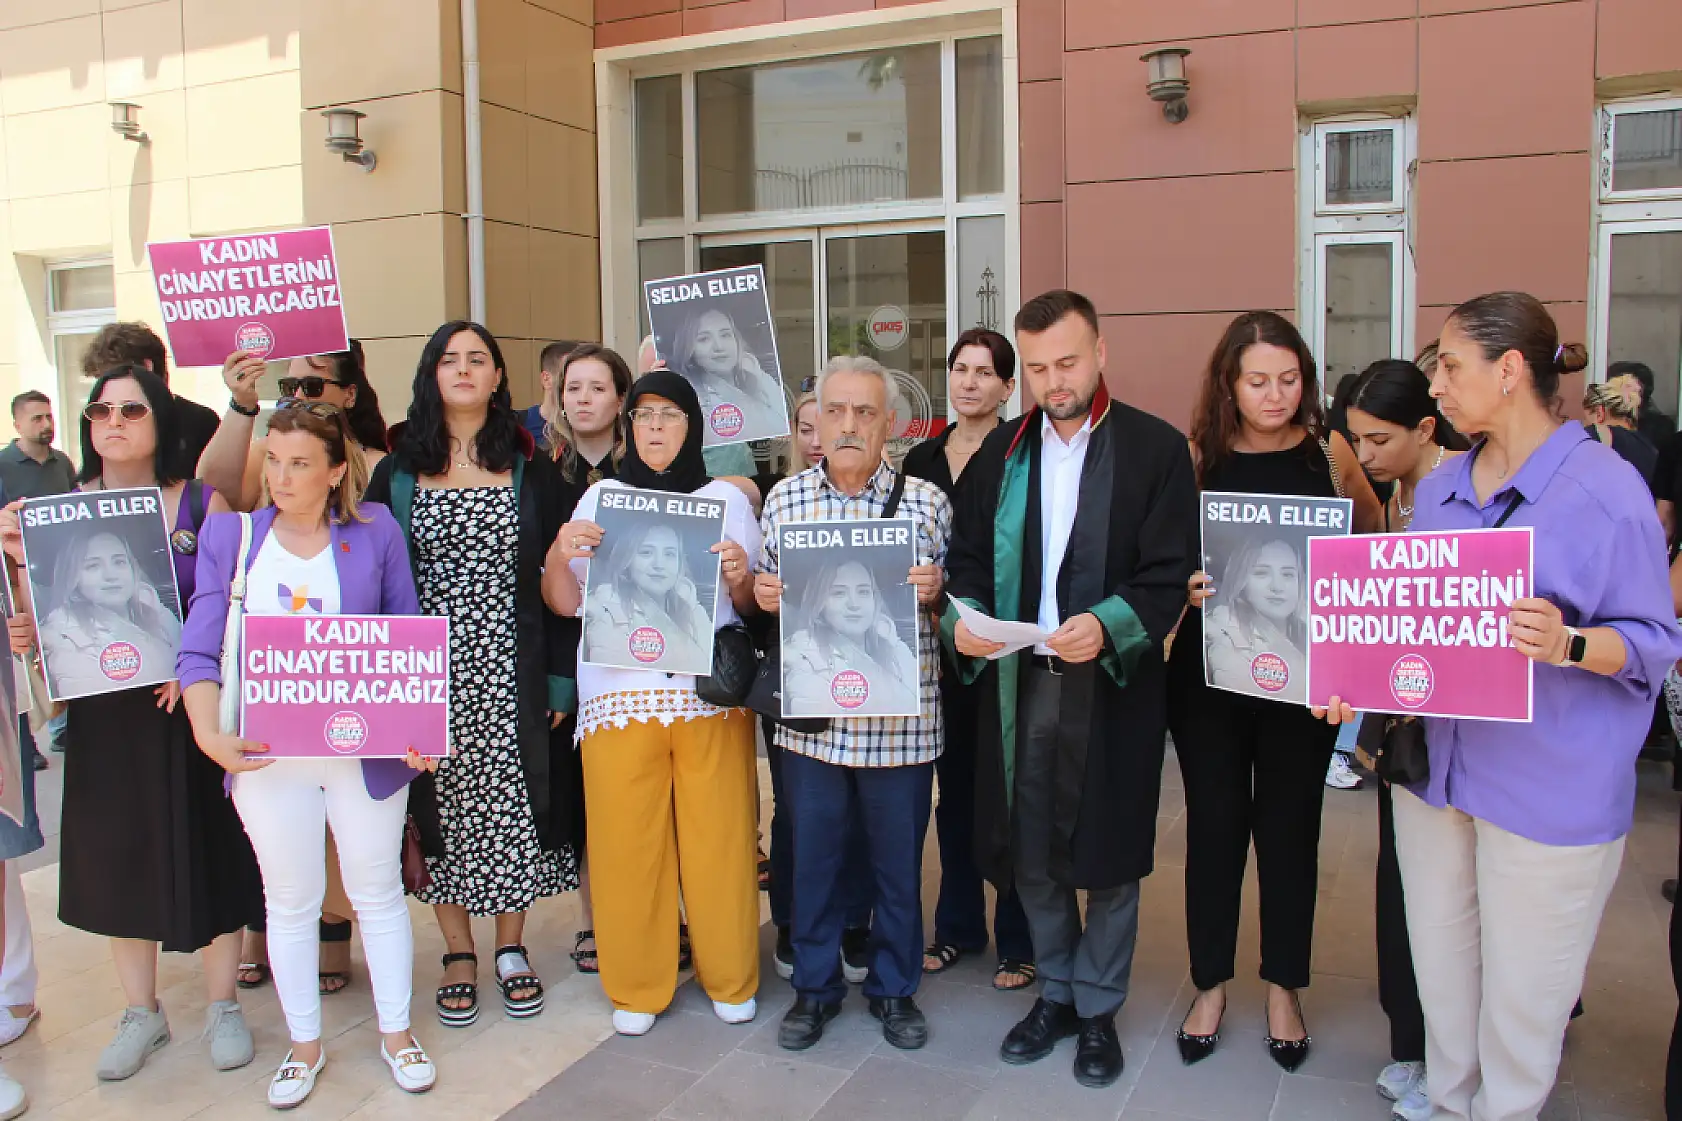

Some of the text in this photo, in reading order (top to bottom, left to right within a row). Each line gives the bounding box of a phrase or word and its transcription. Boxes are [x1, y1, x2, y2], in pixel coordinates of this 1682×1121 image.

[199, 237, 278, 265] KADIN
[158, 254, 333, 295] CİNAYETLERİNİ
[651, 274, 759, 305] SELDA ELLER
[161, 284, 340, 323] DURDURACAĞIZ
[872, 321, 903, 335] ÇIKIŞ
[24, 496, 158, 527] SELDA ELLER
[602, 492, 720, 519] SELDA ELLER
[1207, 502, 1344, 529] SELDA ELLER
[783, 527, 909, 549] SELDA ELLER
[1369, 537, 1459, 570] KADIN
[1313, 569, 1524, 608] CİNAYETLERİNİ
[304, 619, 390, 644] KADIN
[1310, 611, 1517, 648] DURDURACAĞI
[248, 644, 444, 674] CİNAYETLERİNİ
[245, 676, 446, 704] DURDURACAĞIZ
